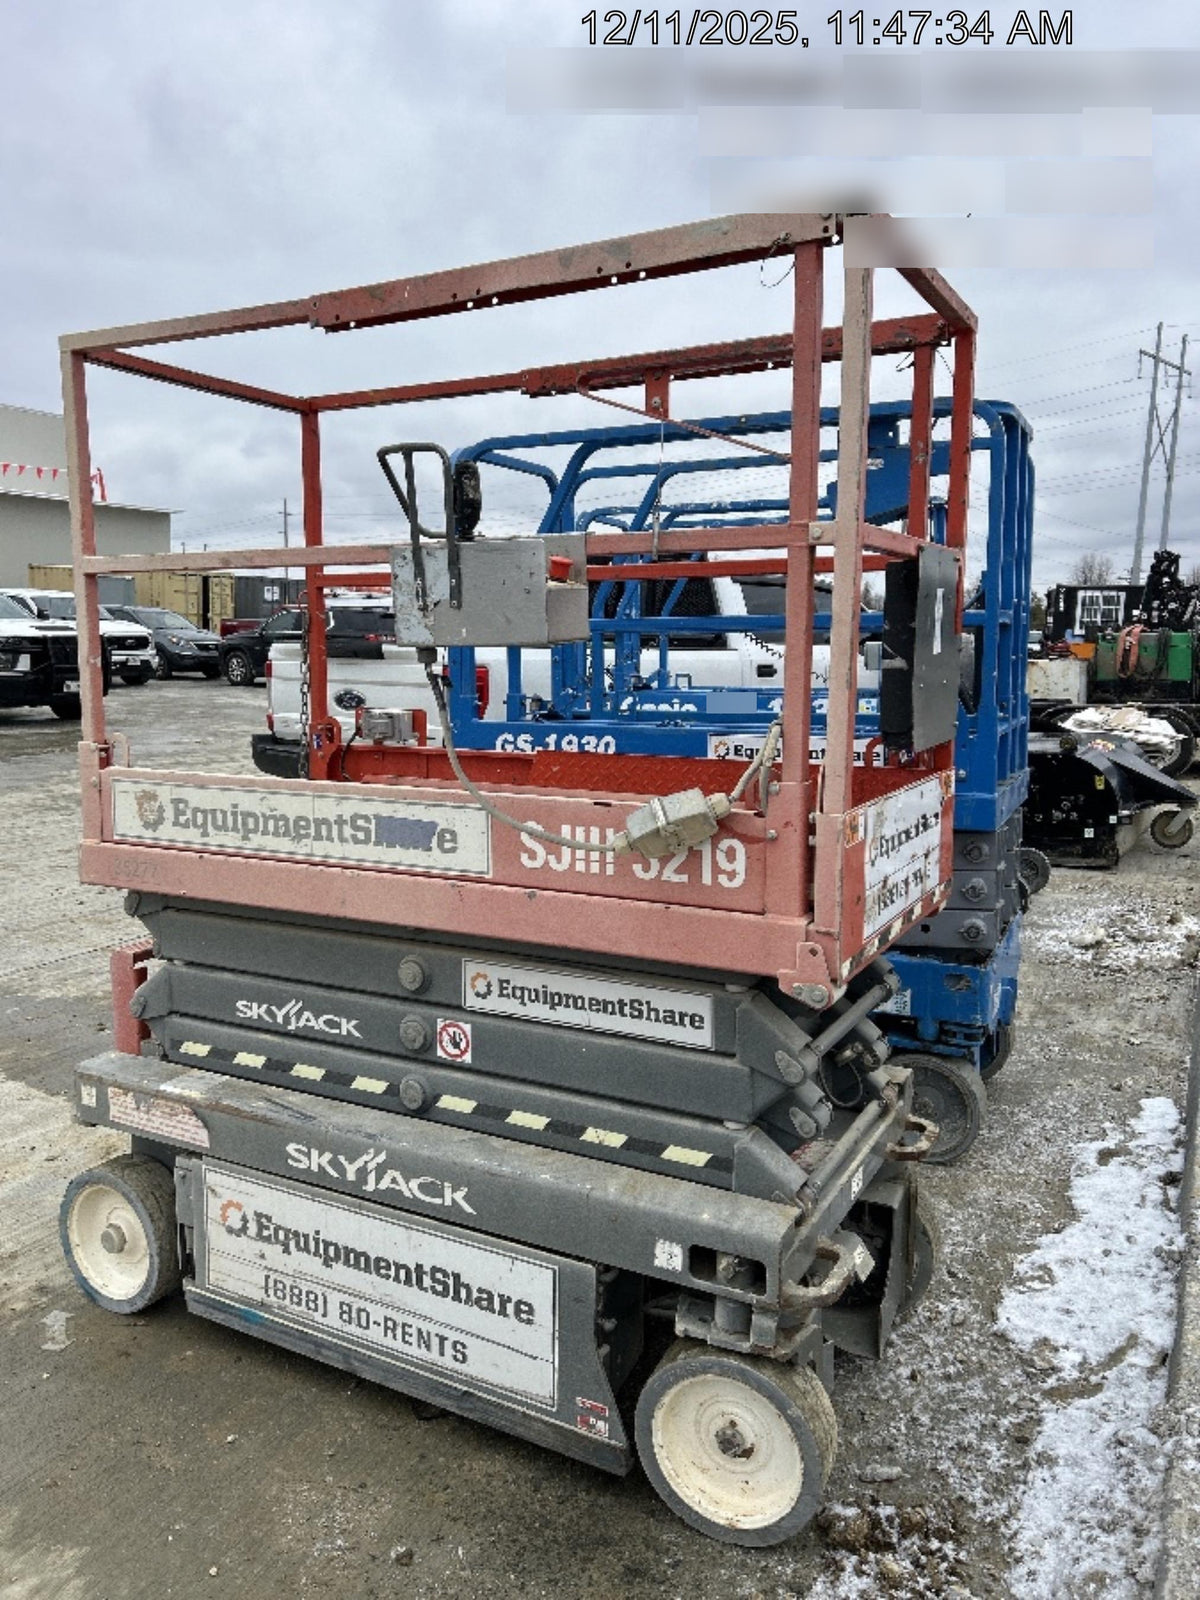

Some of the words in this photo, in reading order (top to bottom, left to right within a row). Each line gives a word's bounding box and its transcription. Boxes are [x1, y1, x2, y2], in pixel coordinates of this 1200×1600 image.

[171, 797, 459, 855] EquipmentSe
[235, 997, 363, 1039] SKYJACK
[498, 978, 706, 1031] EquipmentShare
[285, 1141, 478, 1215] SKYJACK
[254, 1210, 535, 1326] EquipmentShare
[339, 1300, 469, 1364] 80-RENTS
